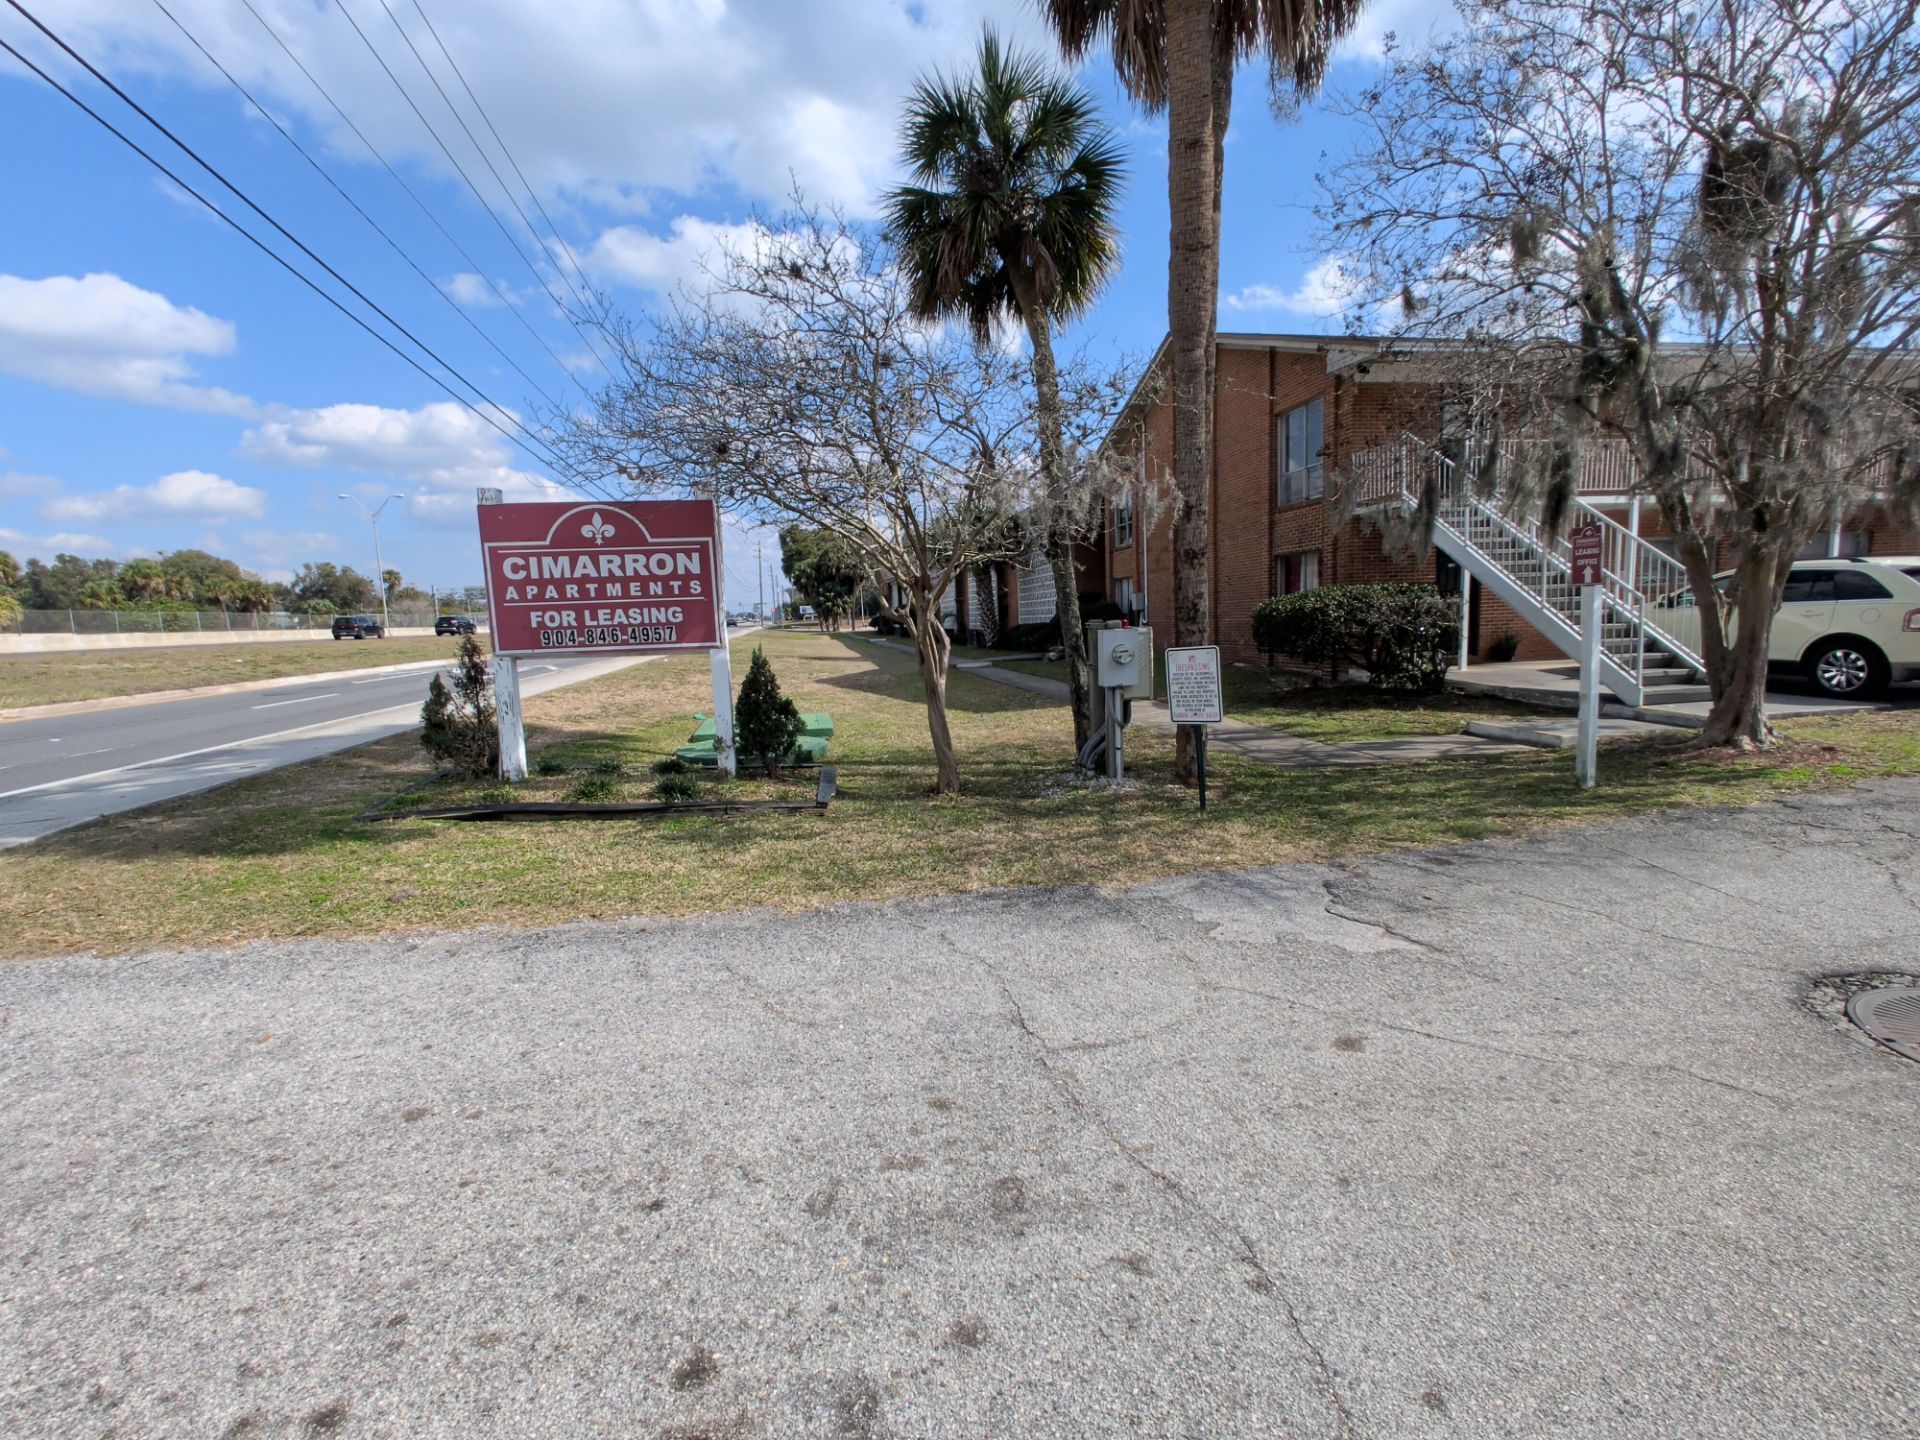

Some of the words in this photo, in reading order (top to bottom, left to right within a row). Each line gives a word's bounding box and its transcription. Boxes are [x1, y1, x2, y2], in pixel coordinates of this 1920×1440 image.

[1575, 547, 1600, 556] LEASING
[502, 552, 701, 580] CIMARRON
[1577, 558, 1598, 566] OFFICE
[506, 580, 702, 600] APARTMENTS
[530, 610, 578, 628] FOR
[584, 606, 684, 627] LEASING
[541, 626, 675, 646] 904-846-4957
[1175, 663, 1211, 671] TRESPASSING
